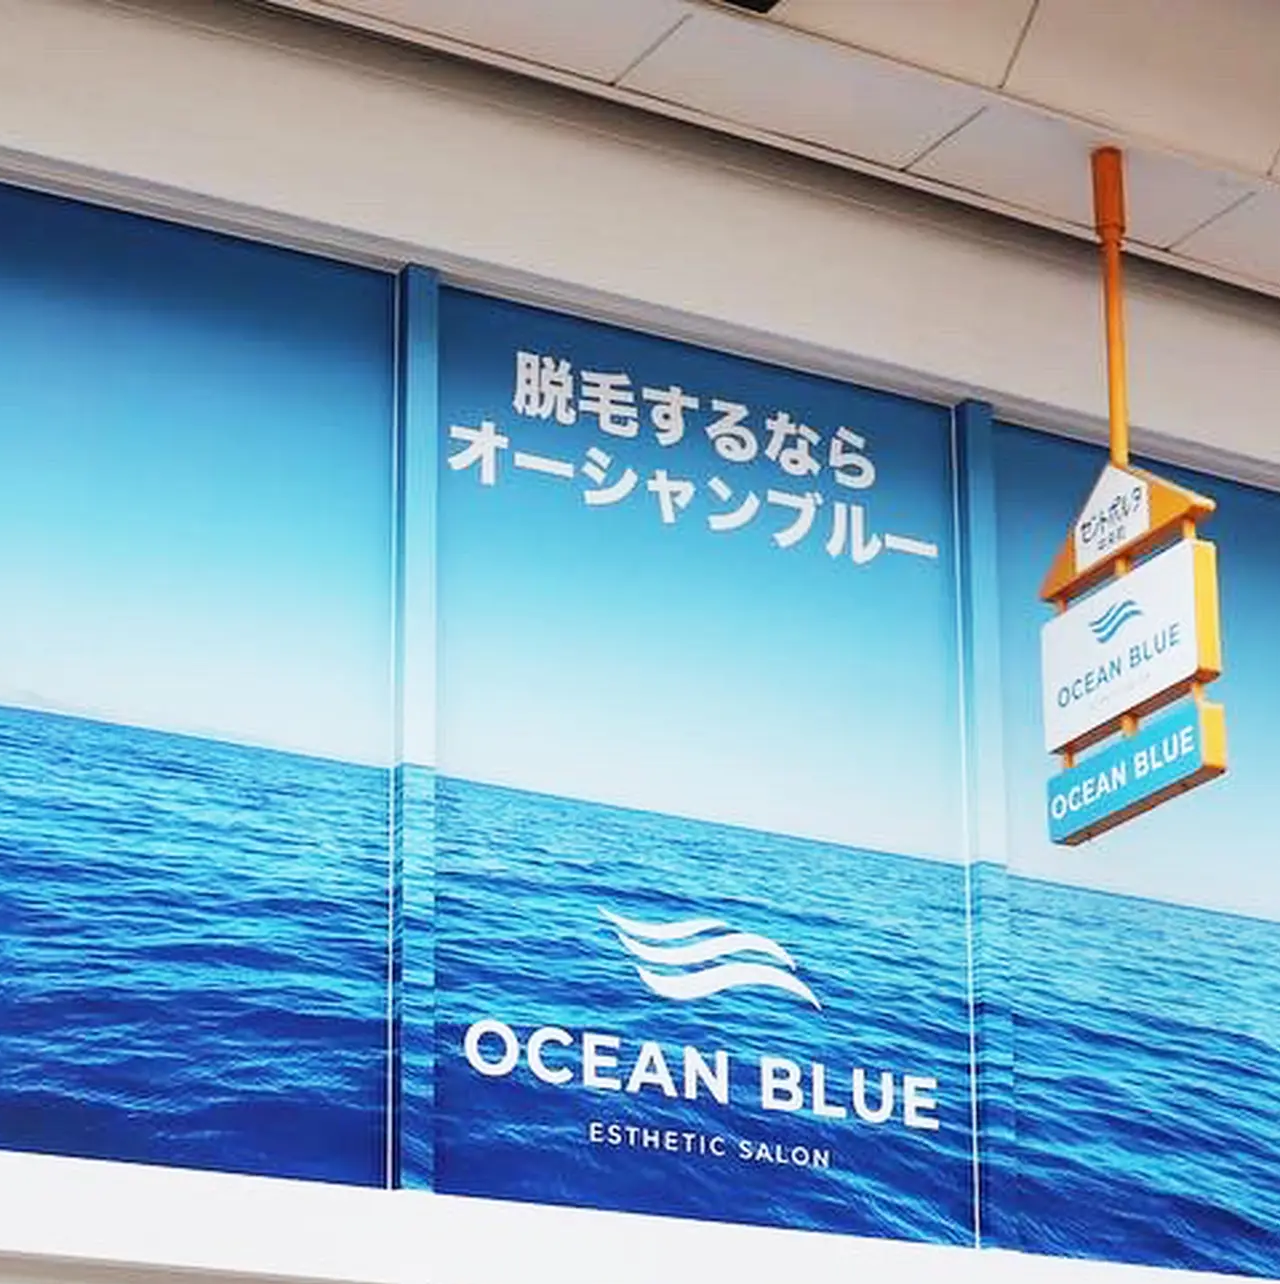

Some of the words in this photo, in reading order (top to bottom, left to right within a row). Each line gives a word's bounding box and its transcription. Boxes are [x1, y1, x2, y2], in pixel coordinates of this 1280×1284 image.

[513, 350, 876, 489] 脱毛するなら
[448, 420, 939, 565] オーシャンブルー
[1057, 656, 1122, 708] OCEAN
[1129, 623, 1181, 669] BLUE
[1050, 762, 1127, 821] OCEAN
[1134, 726, 1196, 777] BLUE
[463, 1018, 730, 1105] OCEAN
[760, 1055, 941, 1130] BLUE
[588, 1121, 727, 1157] ESTHETIC
[738, 1140, 831, 1168] SALON
